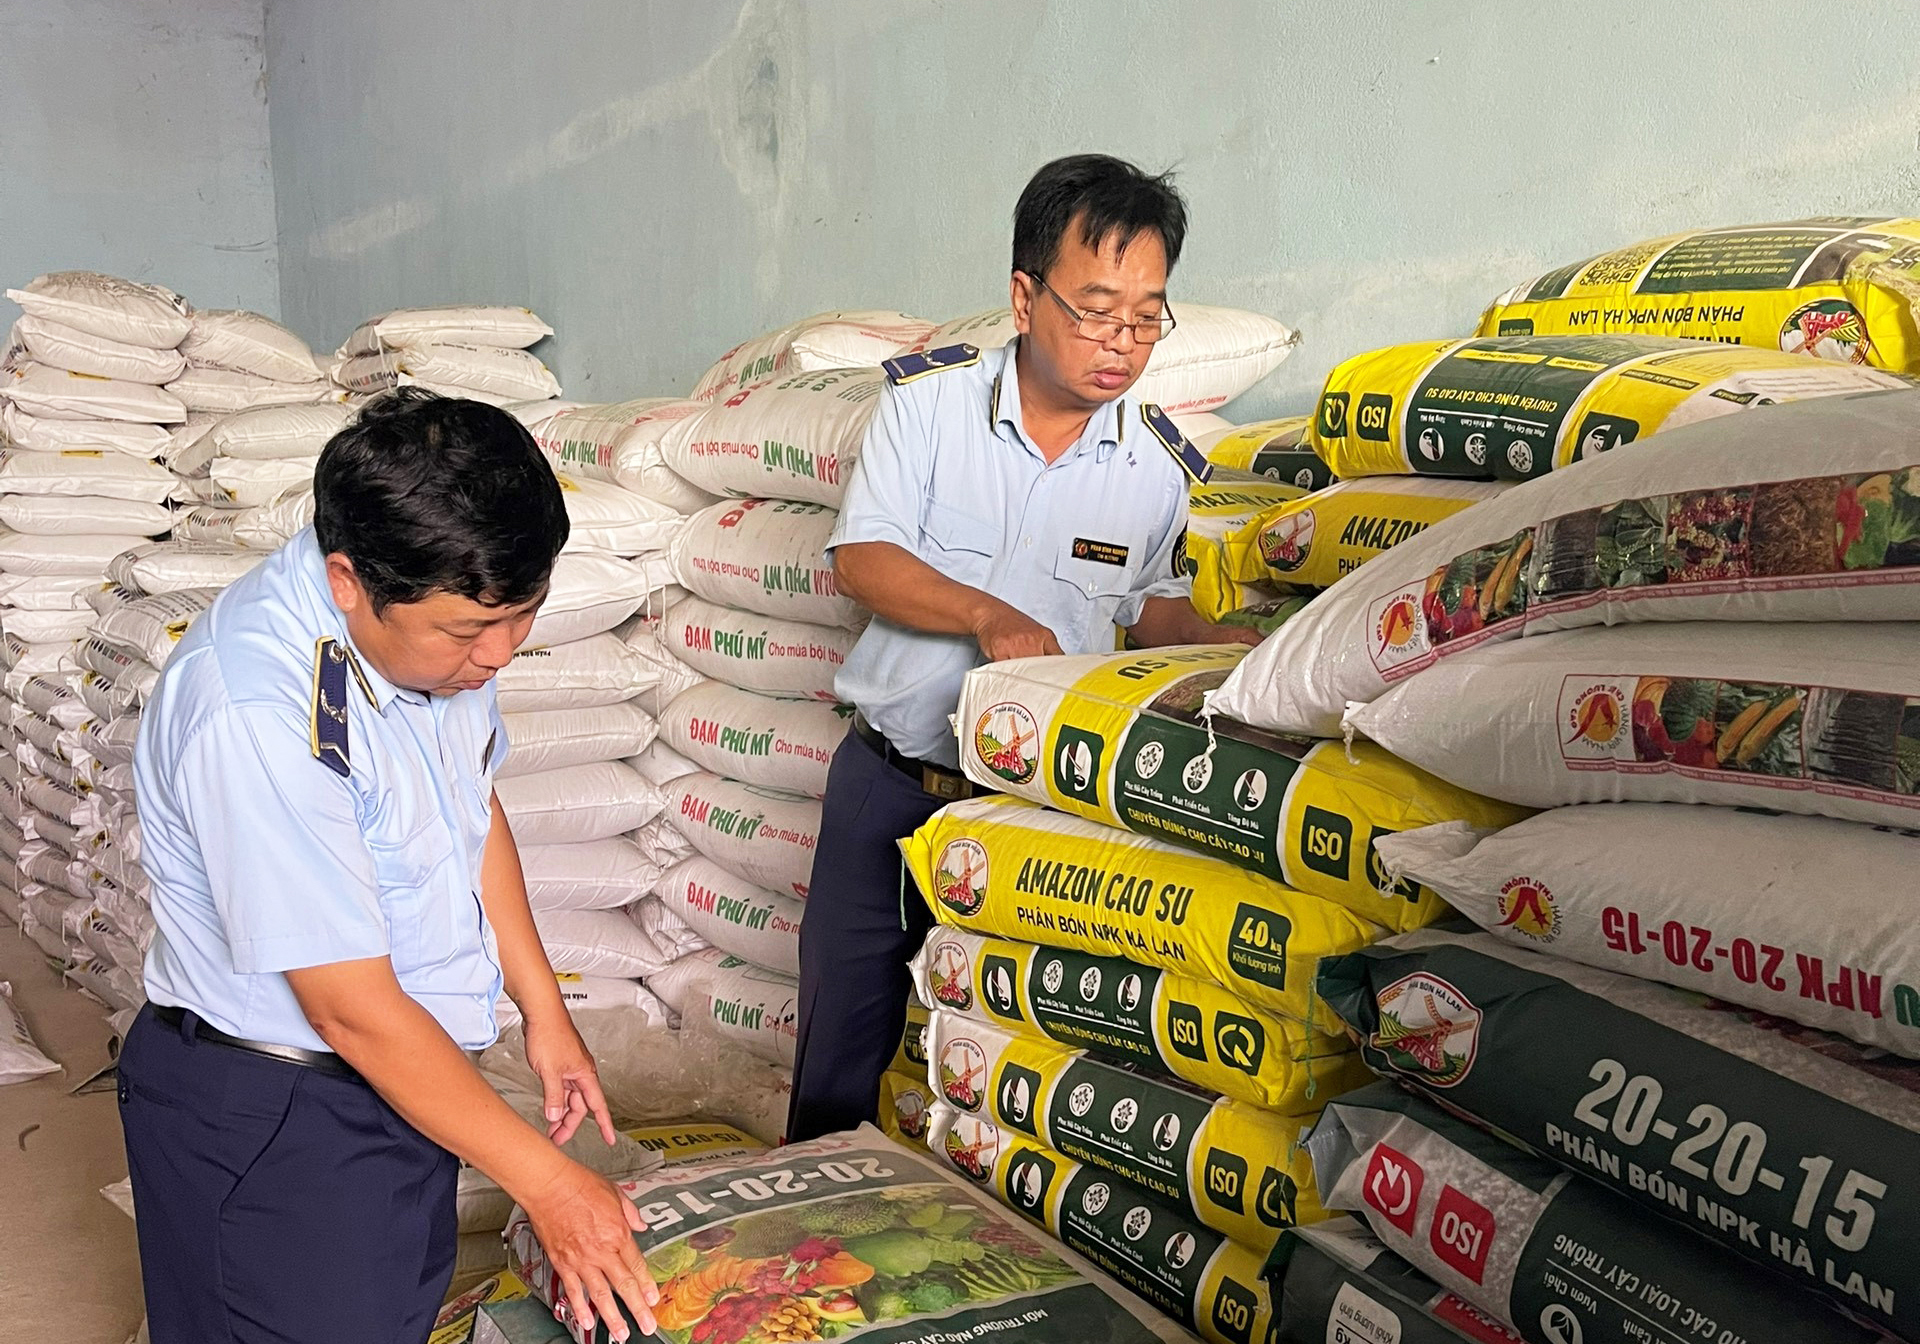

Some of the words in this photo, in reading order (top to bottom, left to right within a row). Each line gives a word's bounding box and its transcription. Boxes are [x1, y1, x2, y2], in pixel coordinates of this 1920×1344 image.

[1569, 309, 1599, 326] LAN
[1626, 308, 1659, 325] NPK
[1698, 305, 1745, 326] PHÂN
[1425, 387, 1438, 398] SU
[1439, 388, 1457, 400] CAO
[1456, 389, 1476, 403] CÂY
[1475, 391, 1495, 402] CHO
[1494, 392, 1520, 406] DNG
[1518, 396, 1558, 413] CHUYÊN
[1361, 405, 1387, 429] ISO
[578, 440, 598, 468] PHÚ
[706, 441, 719, 456] bội
[722, 442, 740, 457] mùa
[741, 444, 759, 460] Cho
[764, 440, 783, 472] MỸ
[786, 445, 815, 478] PHÚ
[816, 453, 840, 485] ĐẠM
[708, 558, 720, 572] bội
[722, 563, 741, 578] mùa
[742, 566, 760, 583] Cho
[763, 565, 782, 597] MỸ
[785, 565, 811, 598] PHÚ
[685, 625, 712, 653] ĐẠM
[714, 629, 743, 659] PHÚ
[747, 631, 768, 660] MỸ
[768, 642, 785, 657] Cho
[787, 643, 807, 658] mùa
[809, 643, 826, 661] bội
[828, 648, 844, 665] thu
[1117, 659, 1170, 681] SU
[690, 717, 719, 749] ĐẠM
[720, 726, 751, 754] PHÚ
[750, 727, 775, 756] MỸ
[775, 739, 792, 755] Cho
[794, 741, 814, 759] mùa
[815, 745, 830, 764] bội
[1141, 785, 1150, 797] Cây
[1172, 795, 1184, 806] Phát
[1184, 797, 1197, 810] Triển
[681, 793, 708, 824] ĐẠM
[708, 806, 739, 835] PHÚ
[736, 814, 765, 840] MỸ
[760, 824, 778, 840] Cho
[780, 827, 800, 844] mùa
[800, 831, 818, 850] bội
[1127, 807, 1161, 830] CHUYÊN
[1162, 818, 1188, 837] DÙNG
[1187, 828, 1207, 844] CHO
[1208, 833, 1229, 851] CÂY
[1228, 842, 1250, 858] CAO
[1227, 812, 1241, 826] Tăng
[1241, 816, 1250, 828] Độ
[1307, 823, 1343, 861] ISO
[1015, 857, 1105, 907] AMAZON
[1104, 873, 1154, 917] CAO
[1155, 883, 1194, 926] SU
[687, 881, 716, 914] ĐẠM
[716, 895, 750, 926] PHÚ
[747, 904, 774, 931] MỸ
[771, 915, 790, 934] Cho
[1498, 897, 1506, 916] CAO
[1017, 906, 1055, 930] PHÂN
[1058, 912, 1090, 937] BÓN
[1091, 923, 1123, 945] NPK
[1125, 928, 1149, 951] HÀ
[1151, 936, 1187, 962] LAN
[1238, 916, 1269, 946] 40
[1270, 937, 1283, 957] kg
[1232, 951, 1248, 966] Khối
[1248, 956, 1268, 973] lượng
[1602, 906, 1787, 992] 20-20-15
[1419, 982, 1435, 993] BÓN
[1435, 988, 1447, 1000] HÀ
[1446, 996, 1463, 1012] LAN
[714, 998, 741, 1025] PHÚ
[742, 1003, 765, 1030] MỸ
[1093, 1033, 1109, 1044] CHO
[1123, 1040, 1139, 1052] CAO
[1139, 1044, 1151, 1056] SU
[1173, 1017, 1198, 1046] ISO
[676, 1134, 711, 1148] CAO
[715, 1132, 743, 1143] SU
[724, 1150, 747, 1158] LAN
[1574, 1058, 1888, 1253] 20-20-15
[639, 1157, 895, 1232] 20-20-15
[1131, 1170, 1148, 1186] CÂY
[1148, 1178, 1166, 1194] CAO
[1167, 1186, 1180, 1199] SU
[1210, 1163, 1238, 1198] ISO
[1545, 1122, 1622, 1180] PHÂN
[1628, 1161, 1689, 1212] BÓN
[1697, 1195, 1762, 1249] NPK
[1769, 1231, 1817, 1277] HÀ
[1825, 1258, 1895, 1316] LAN
[1440, 1211, 1484, 1261] ISO
[1553, 1234, 1605, 1274] TRỒNG
[1120, 1269, 1137, 1286] CHO
[1137, 1280, 1155, 1297] CÂY
[1154, 1290, 1171, 1307] CAO
[1544, 1271, 1568, 1296] Chồi
[1604, 1264, 1640, 1291] CÂY
[1218, 1293, 1248, 1332] ISO
[1639, 1284, 1681, 1318] LOẠI
[1022, 1308, 1048, 1323] MÔI
[1680, 1308, 1718, 1339] CÁC
